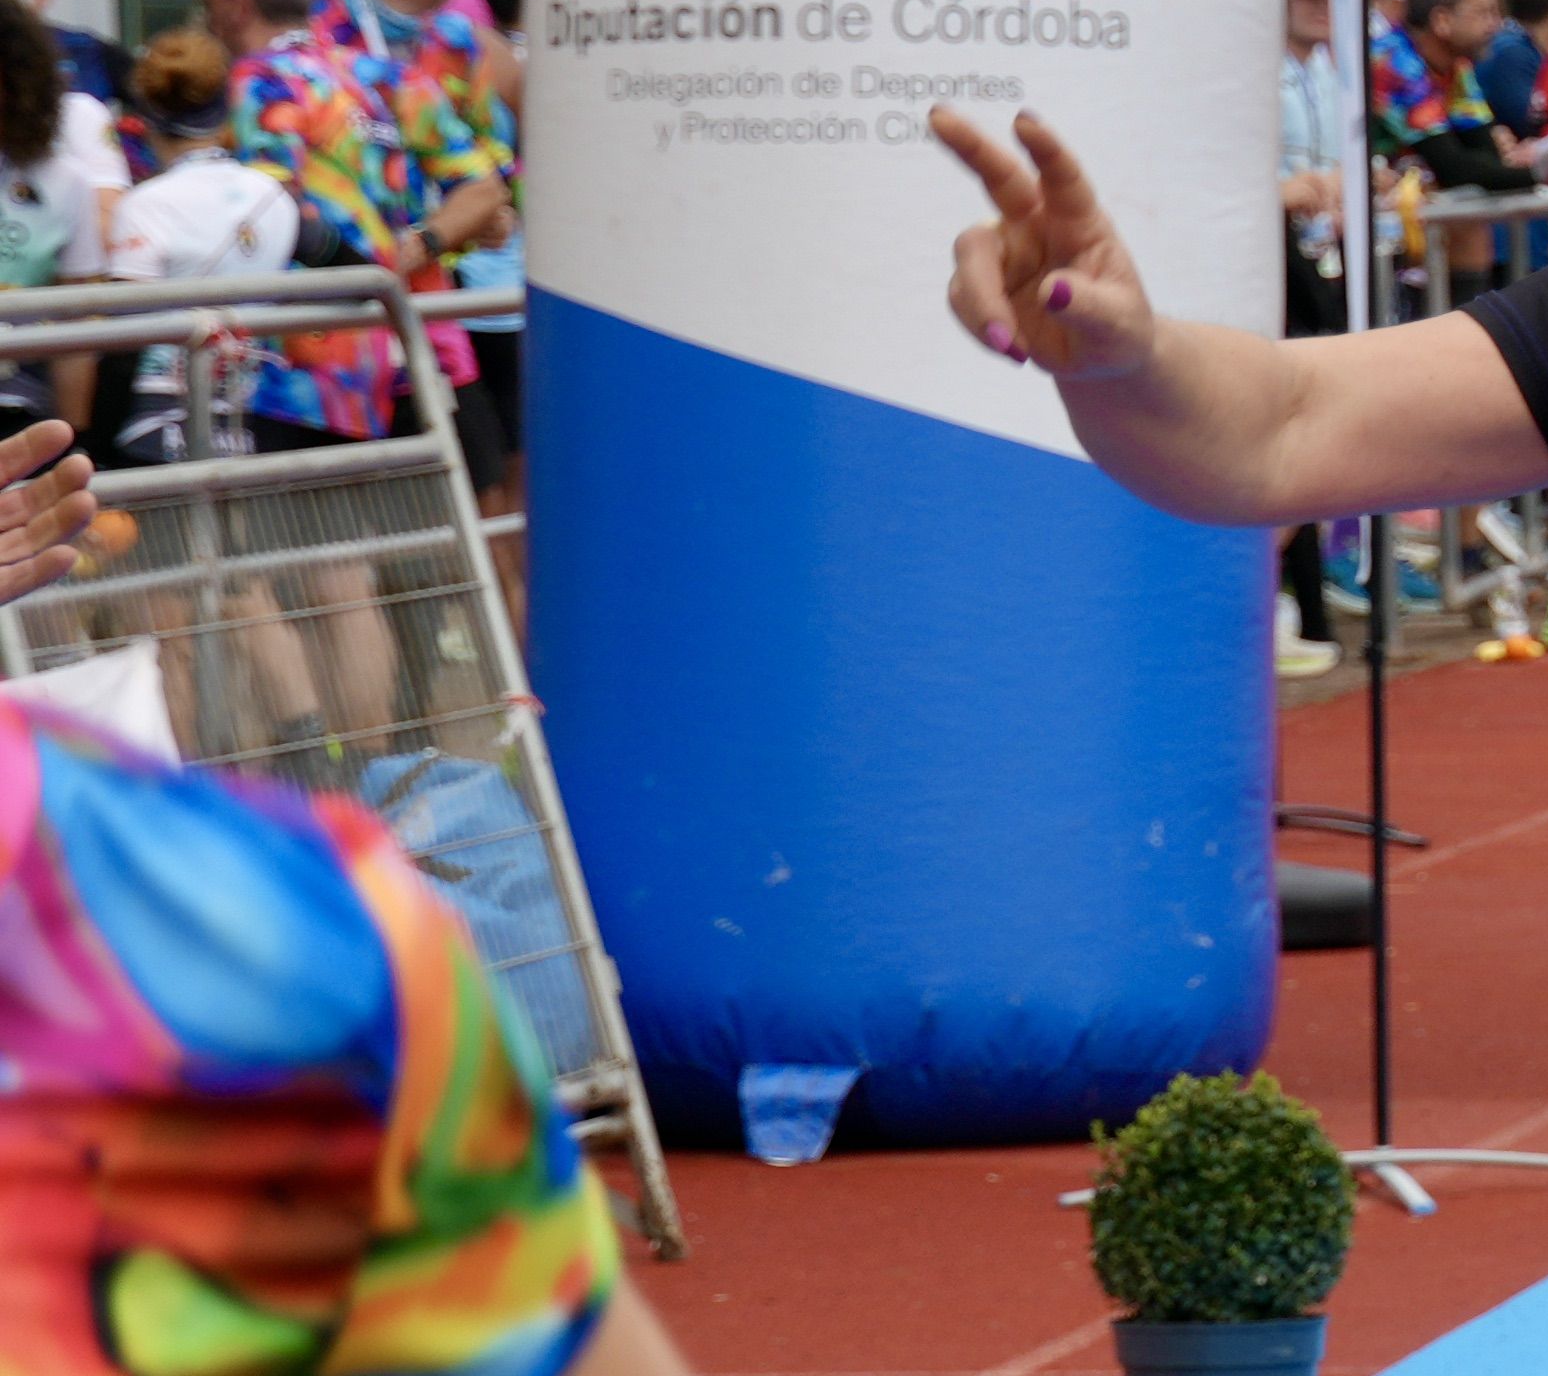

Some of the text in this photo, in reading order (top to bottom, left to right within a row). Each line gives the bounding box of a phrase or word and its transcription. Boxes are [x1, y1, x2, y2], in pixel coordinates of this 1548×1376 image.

[606, 65, 1024, 106] Delegación de Deportes
[680, 111, 868, 145] Protección
